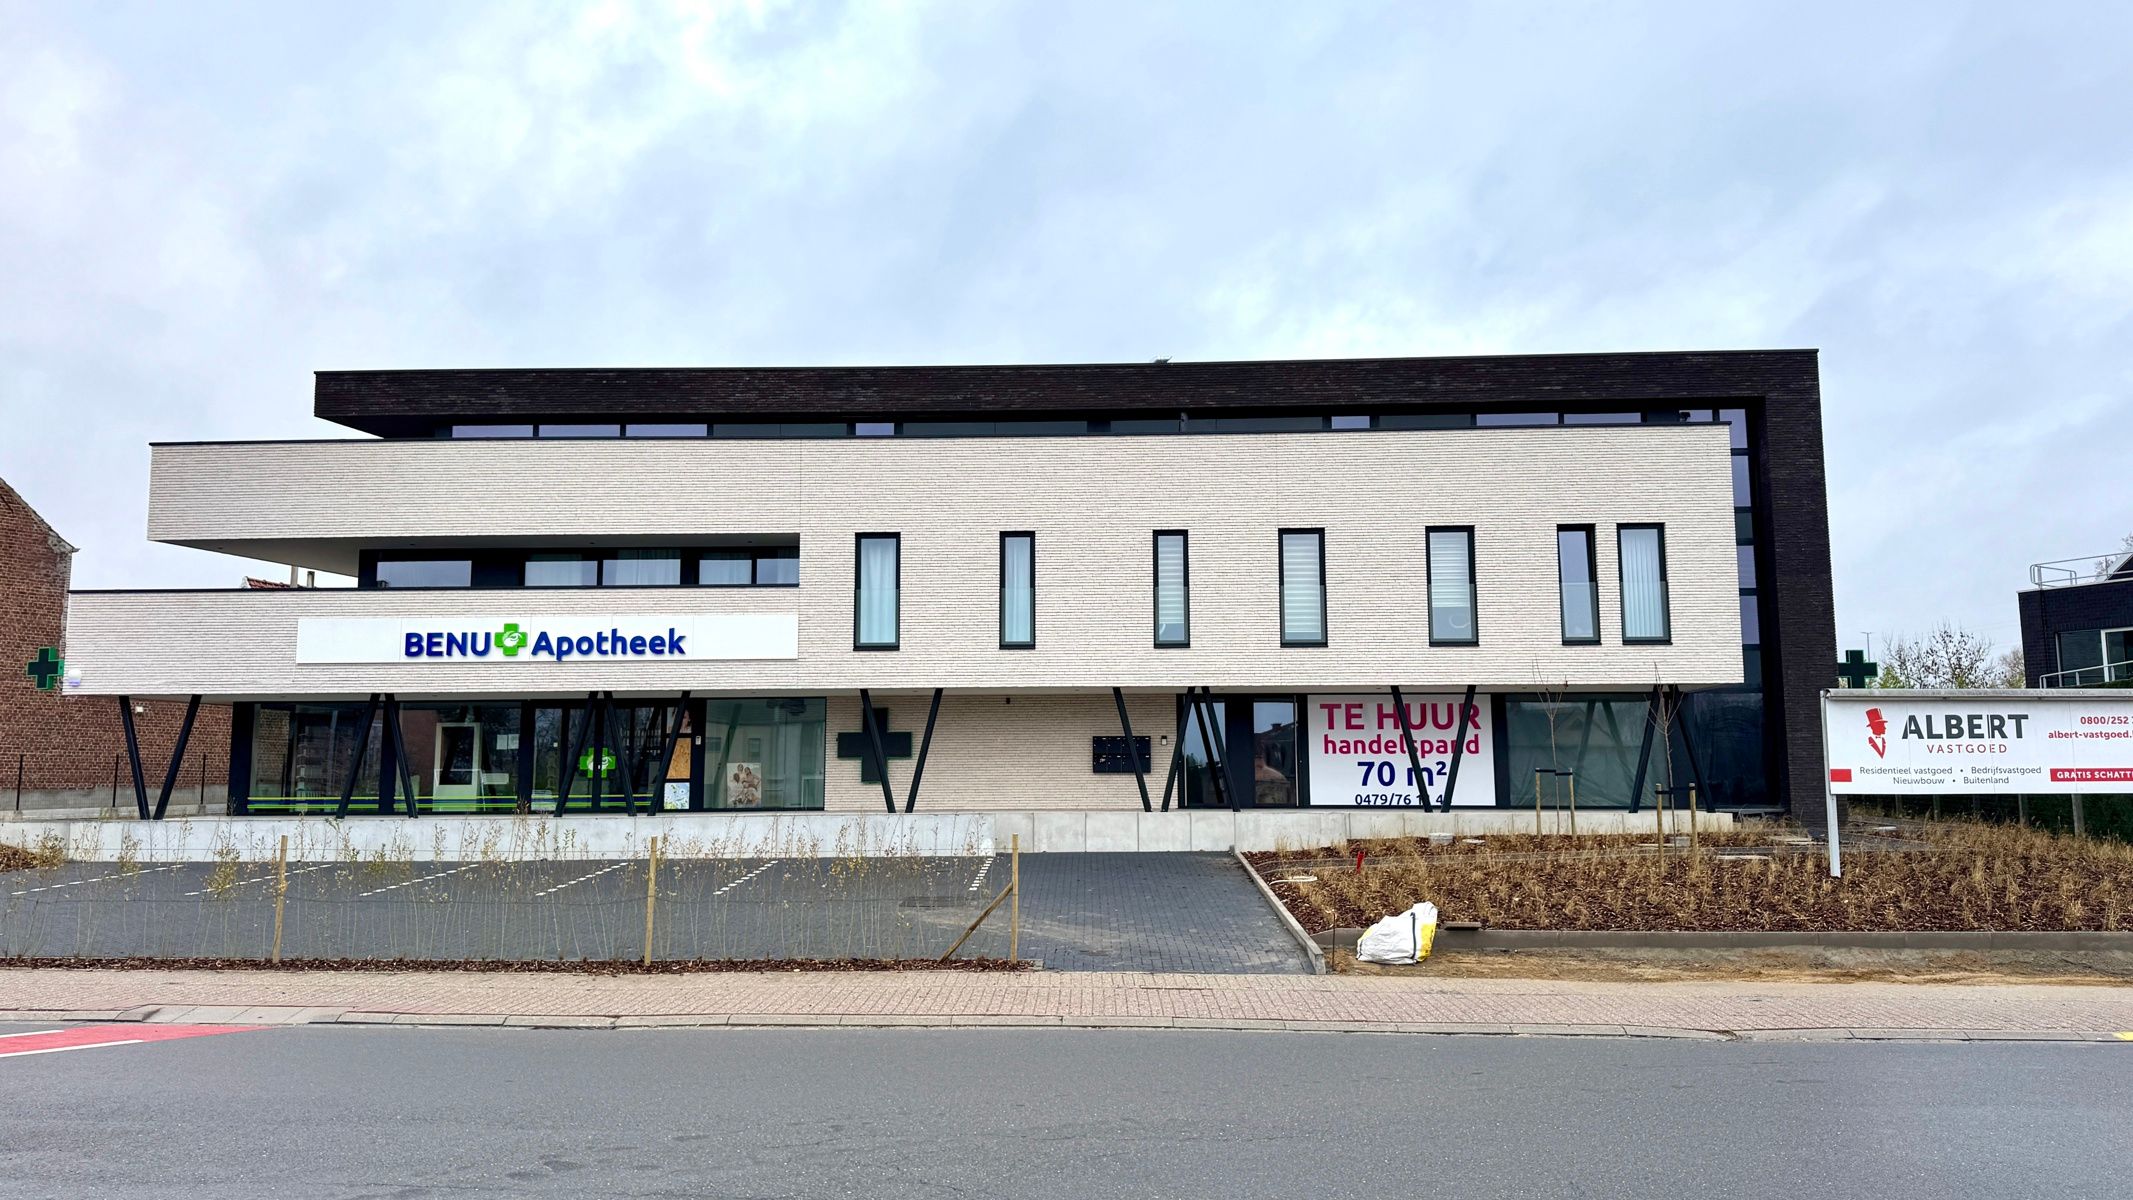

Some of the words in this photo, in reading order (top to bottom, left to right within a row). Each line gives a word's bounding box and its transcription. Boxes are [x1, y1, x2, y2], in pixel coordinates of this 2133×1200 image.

[404, 632, 491, 657] BENU
[531, 628, 686, 661] Apotheek
[1319, 703, 1364, 730] TE
[1377, 703, 1481, 730] HUUR
[2080, 716, 2129, 725] 0800/252
[1902, 714, 2028, 740] ALBERT
[1926, 744, 2007, 754] VASTGOED
[1357, 761, 1396, 787] 70
[1859, 766, 1911, 775] Residentieel
[1914, 766, 1953, 776] vastgoed
[1971, 766, 2042, 776] Bedrijfsvastgoed
[2057, 771, 2092, 779] GRATIS
[1893, 776, 1945, 785] Nieuwbouw
[1963, 776, 2009, 785] Buitenland
[1354, 793, 1412, 805] 0479/76
